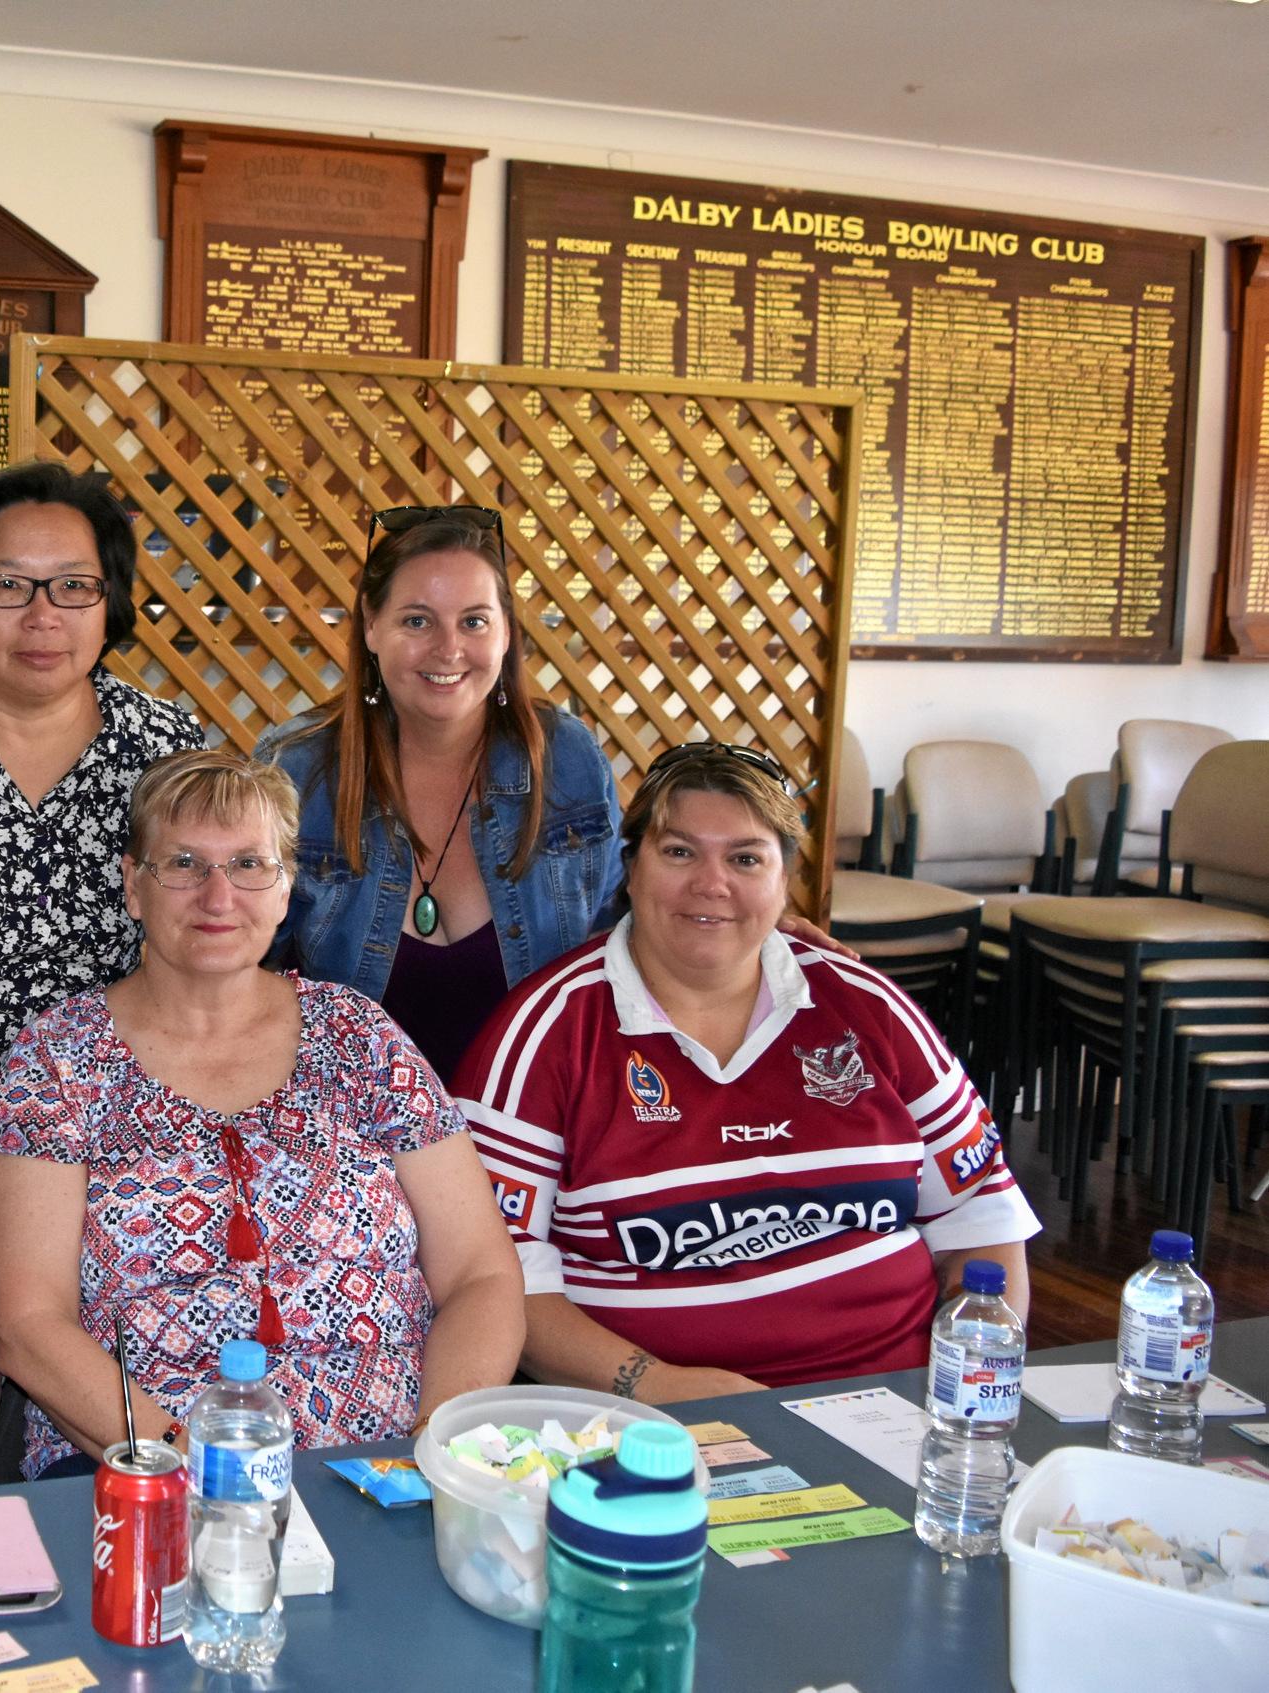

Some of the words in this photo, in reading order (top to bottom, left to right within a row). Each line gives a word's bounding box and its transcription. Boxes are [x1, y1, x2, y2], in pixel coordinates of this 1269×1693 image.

[242, 155, 304, 181] DALBY
[323, 157, 388, 187] LADIES
[246, 182, 329, 205] BOWLING
[337, 190, 381, 209] CLUB
[633, 195, 741, 228] DALBY
[752, 206, 865, 241] LADIES
[888, 220, 1019, 258] BOWLING
[1031, 236, 1105, 265] CLUB
[557, 237, 612, 255] PRESIDENT
[626, 243, 680, 261] SECRETARY
[695, 249, 747, 267] TREASURER
[815, 239, 887, 257] HONOUR
[896, 246, 948, 263] BOARD
[636, 1088, 660, 1098] NRL
[632, 1105, 681, 1117] TELSTRA
[636, 1114, 682, 1123] PREMIERSHIP
